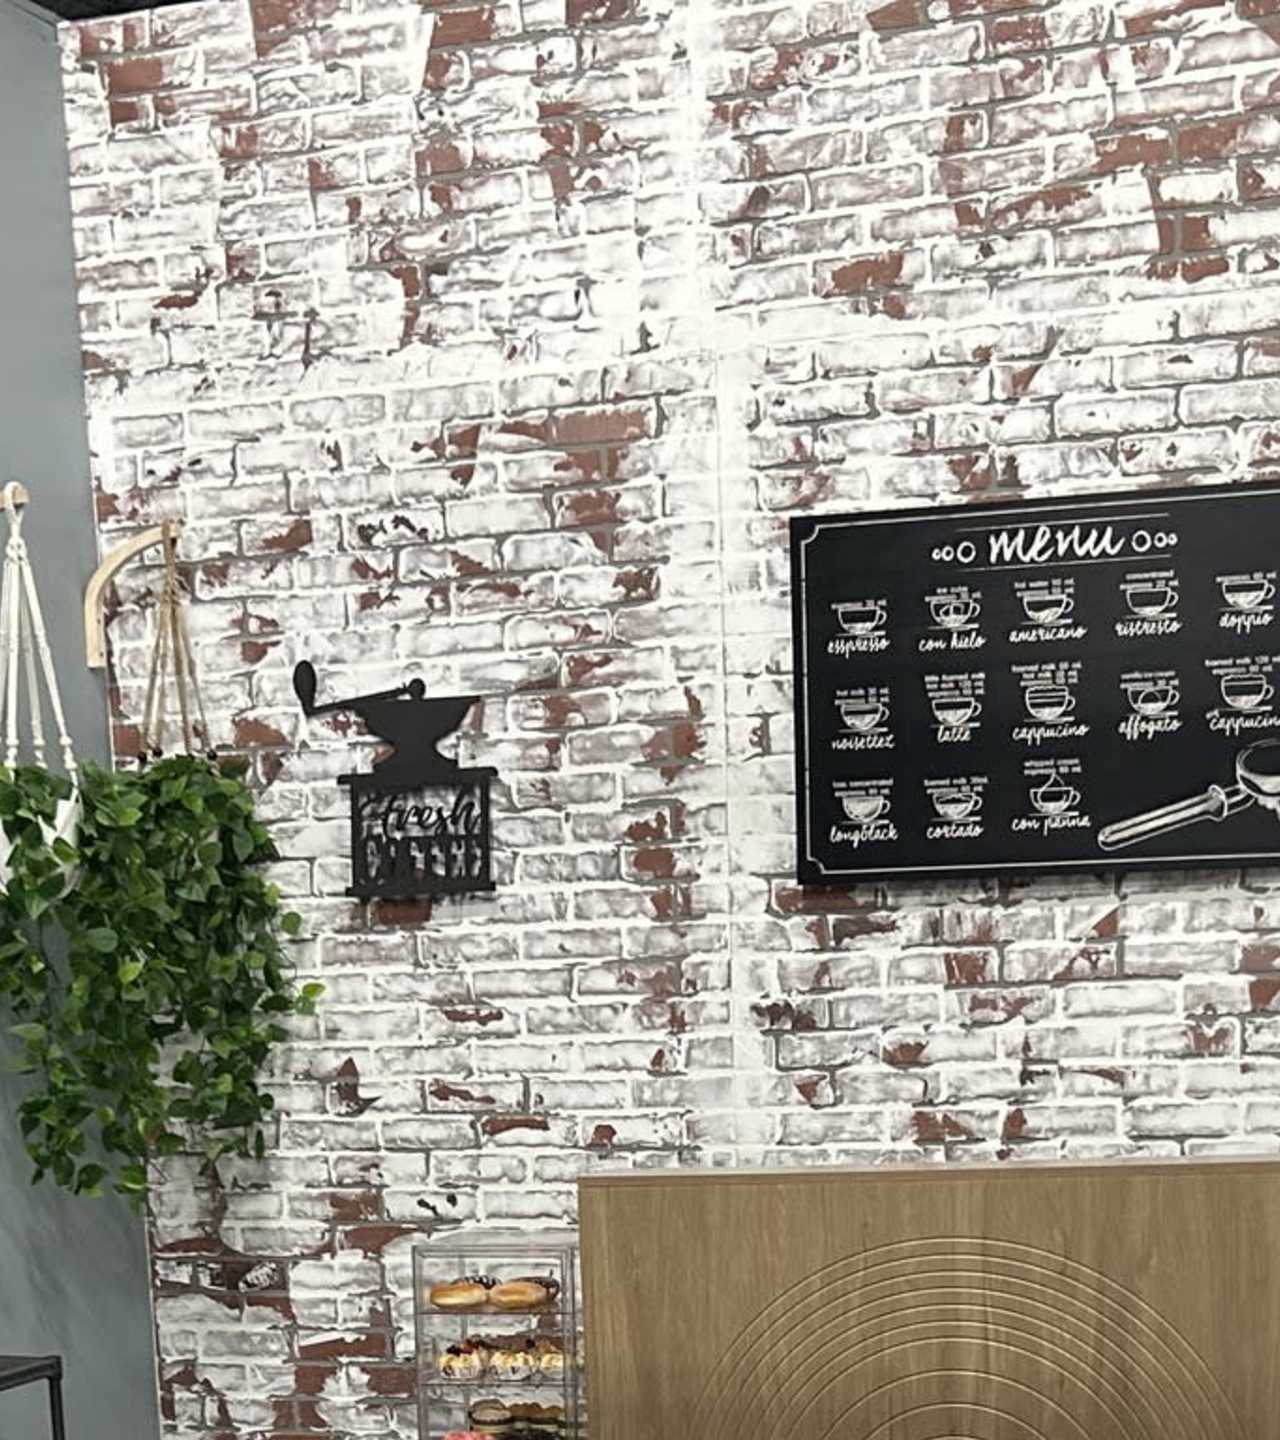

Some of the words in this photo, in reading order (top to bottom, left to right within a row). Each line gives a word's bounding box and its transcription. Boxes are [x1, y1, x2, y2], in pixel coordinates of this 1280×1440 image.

[989, 524, 1125, 563] menu
[1009, 626, 1088, 643] americano
[1219, 613, 1274, 635] doppio
[918, 638, 947, 652] con
[937, 725, 972, 743] latte
[1012, 724, 1091, 746] cappucino
[1118, 714, 1183, 740] affogato
[926, 825, 984, 839] cortado
[1011, 817, 1040, 831] con
[1043, 815, 1092, 836] panna
